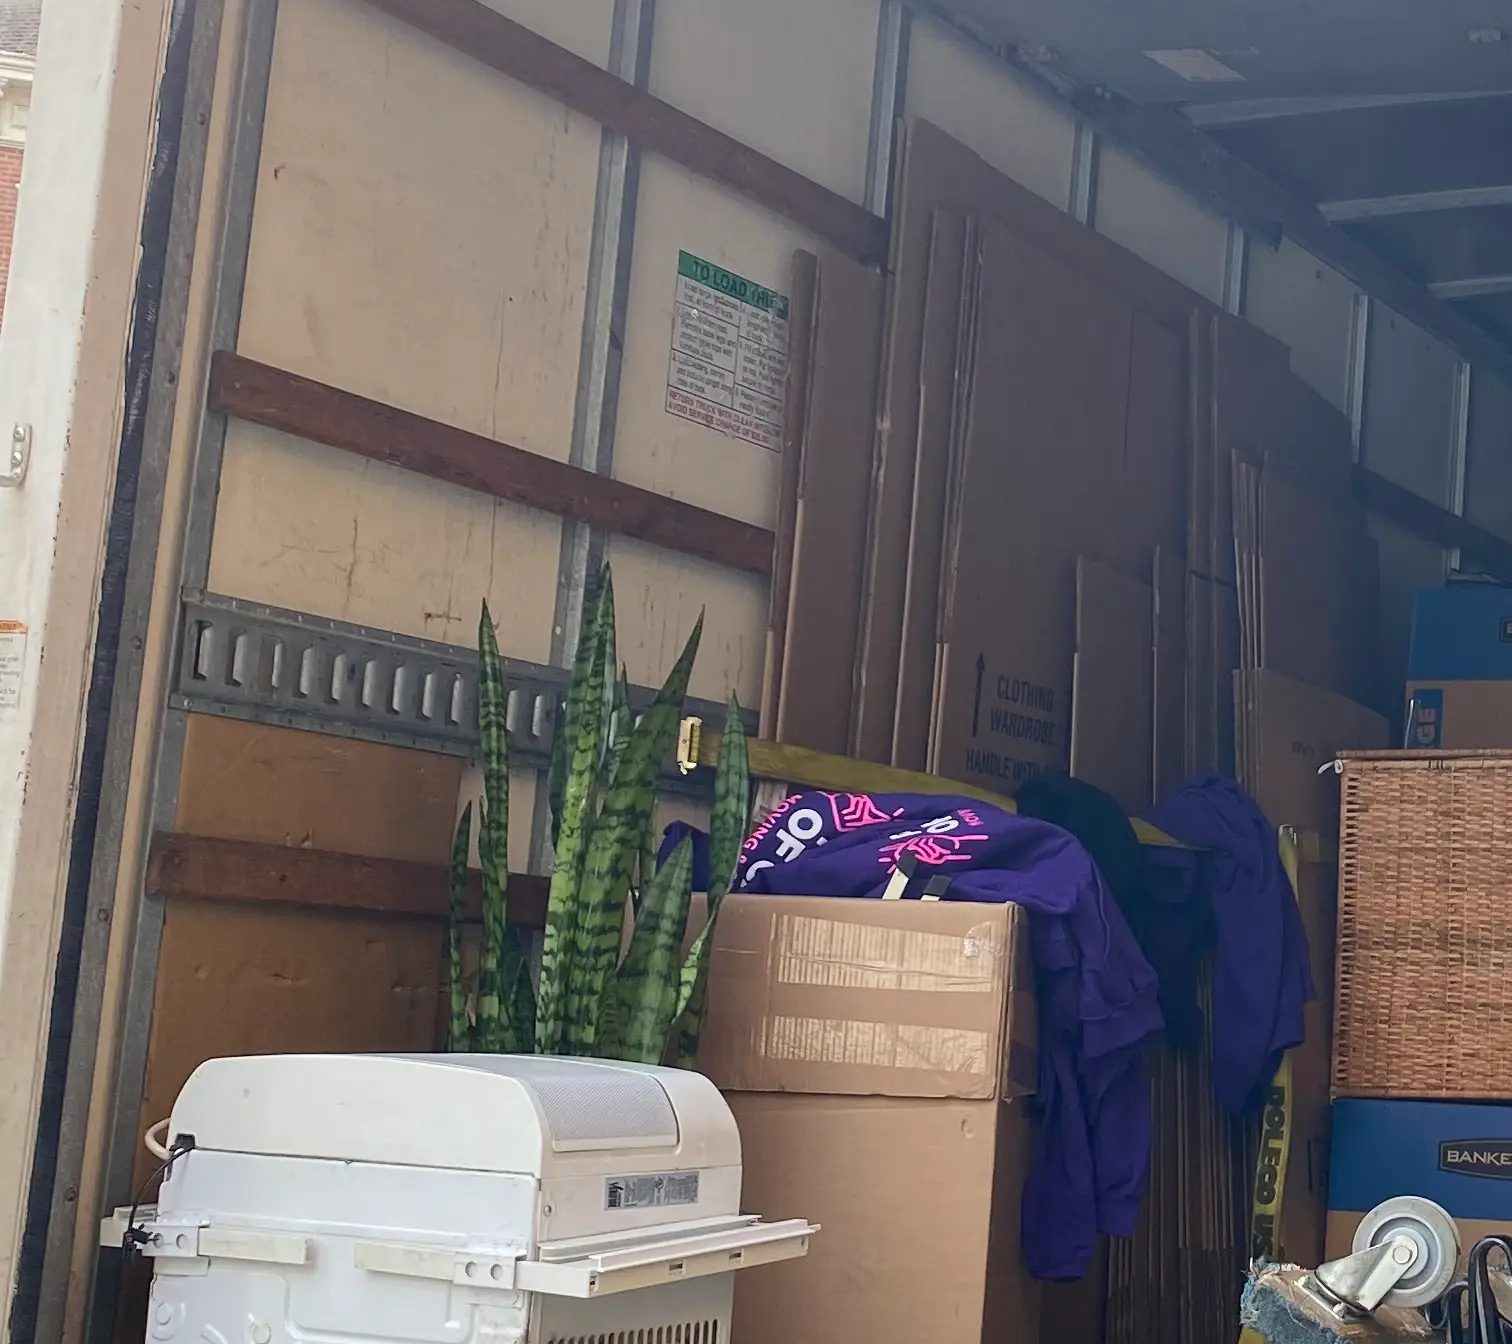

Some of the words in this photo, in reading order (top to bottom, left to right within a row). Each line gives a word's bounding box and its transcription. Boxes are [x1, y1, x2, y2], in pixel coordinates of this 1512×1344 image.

[693, 259, 710, 281] TO
[713, 270, 748, 297] LOAD
[997, 674, 1055, 713] CLOTHING
[990, 706, 1057, 746] WARDROBE
[1416, 707, 1436, 743] GE
[965, 746, 1011, 779] HANDLE
